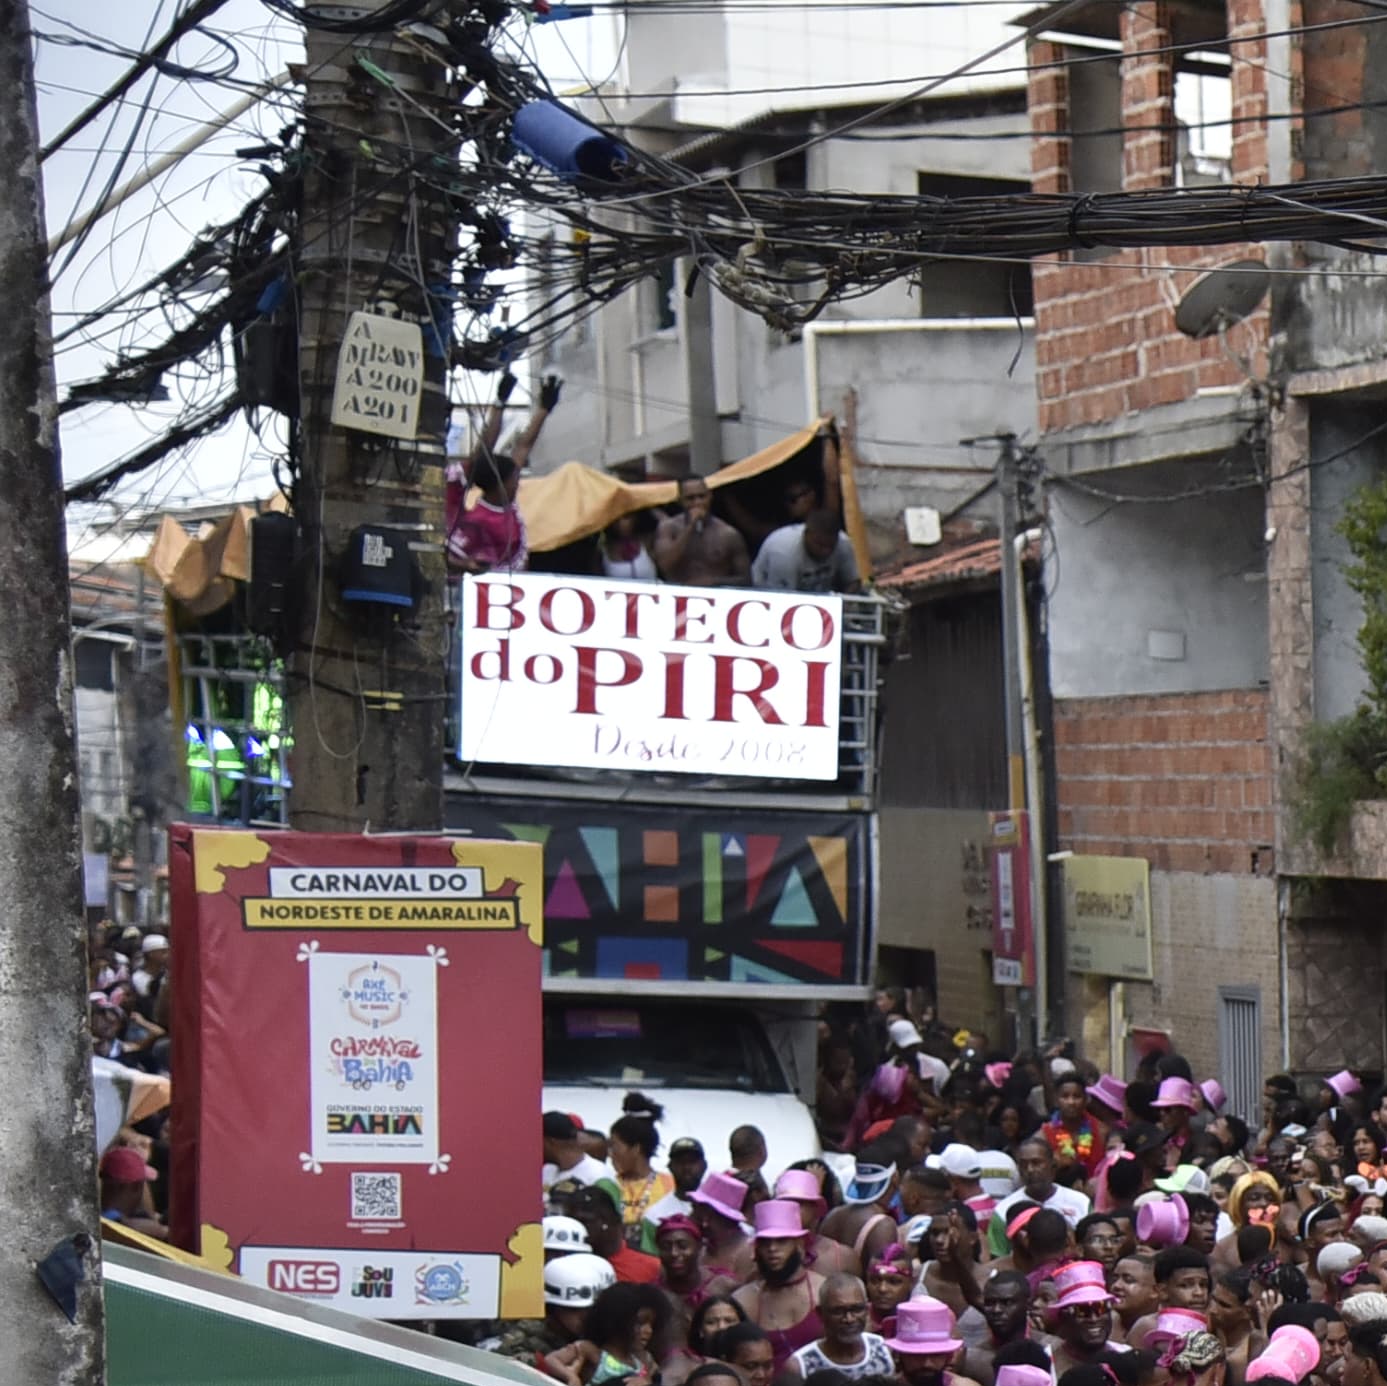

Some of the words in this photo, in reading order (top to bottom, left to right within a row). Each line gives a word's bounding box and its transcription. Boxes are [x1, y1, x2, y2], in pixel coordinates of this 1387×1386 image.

[346, 367, 418, 396] A200
[343, 393, 408, 423] A201
[472, 582, 834, 650] BOTECO
[470, 638, 563, 684] do
[570, 645, 831, 727] PIRI
[593, 724, 700, 761] Desde
[290, 873, 422, 892] CARNAVAL
[428, 873, 467, 892] DO
[260, 905, 363, 921] NORDESTE
[369, 905, 393, 921] DE
[397, 906, 510, 922] AMARALINA
[354, 990, 395, 1003] MUSIC
[327, 1113, 424, 1135] BAHIA
[274, 1263, 338, 1290] NES
